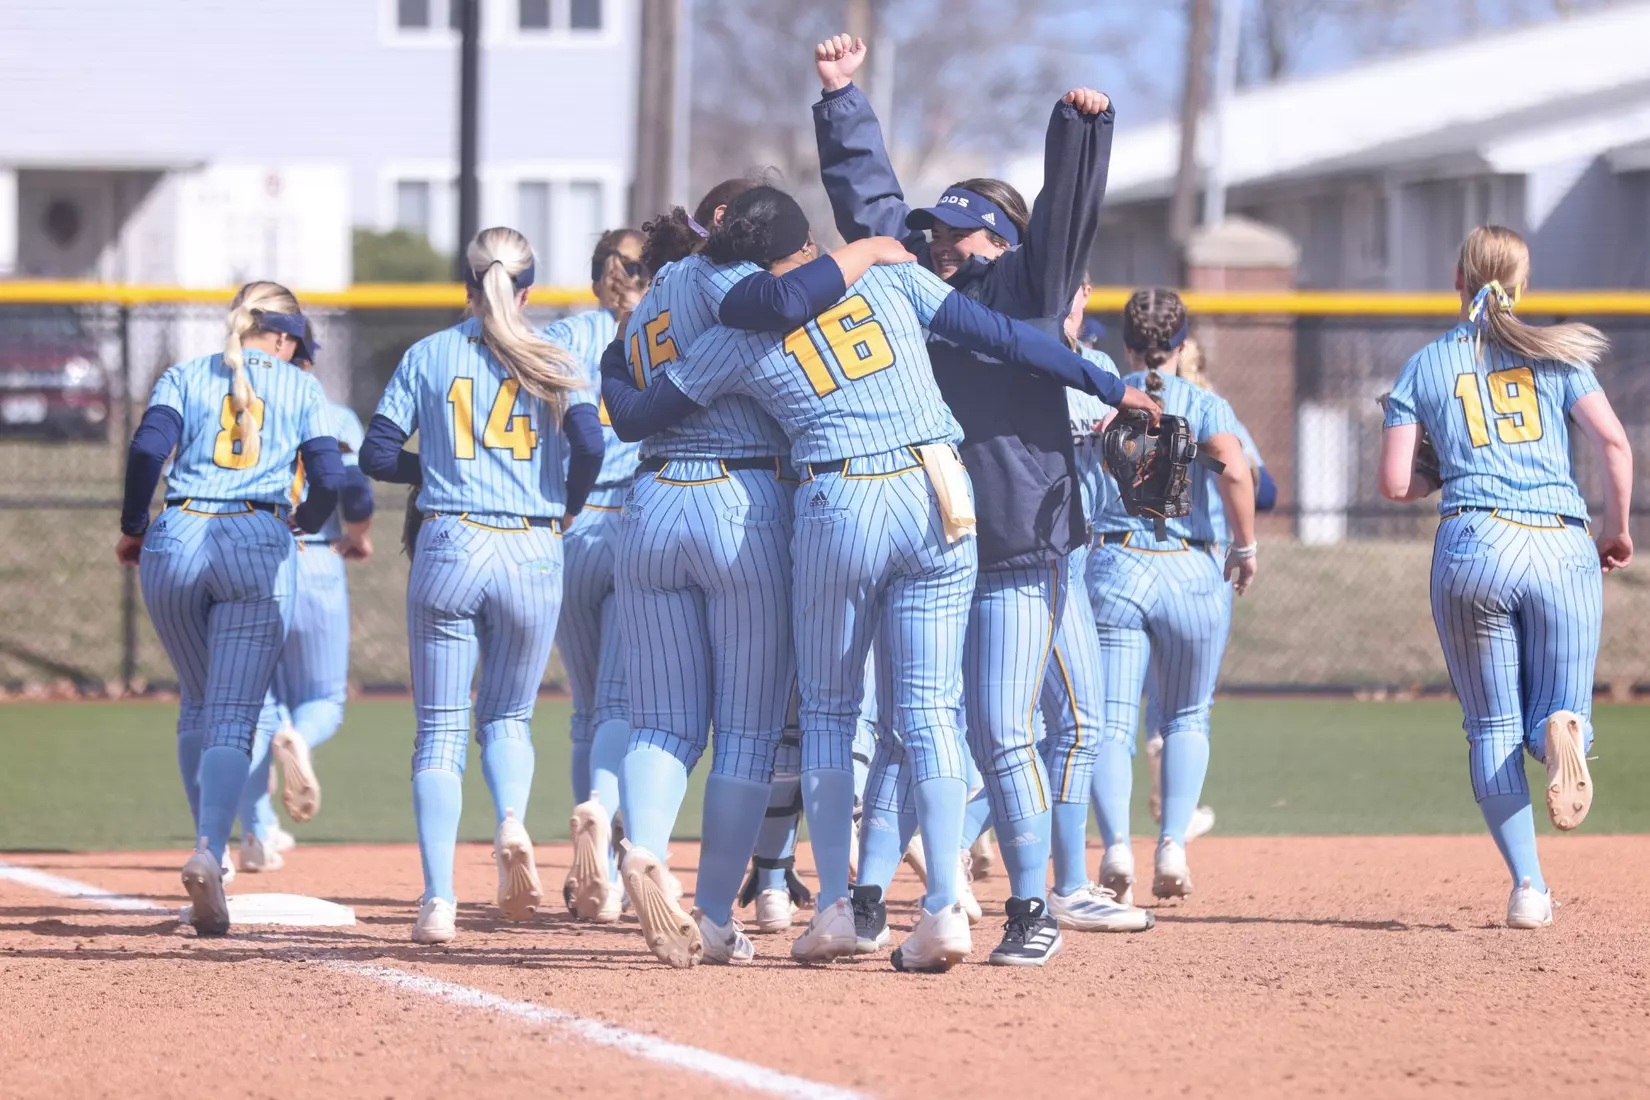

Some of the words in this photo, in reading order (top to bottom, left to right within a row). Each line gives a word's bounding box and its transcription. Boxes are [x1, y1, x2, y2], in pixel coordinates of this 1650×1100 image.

[938, 195, 969, 207] OOS
[628, 308, 682, 392] 15
[782, 293, 896, 399] 16
[212, 392, 265, 471] 8
[447, 376, 538, 460] 14
[1453, 366, 1544, 448] 19
